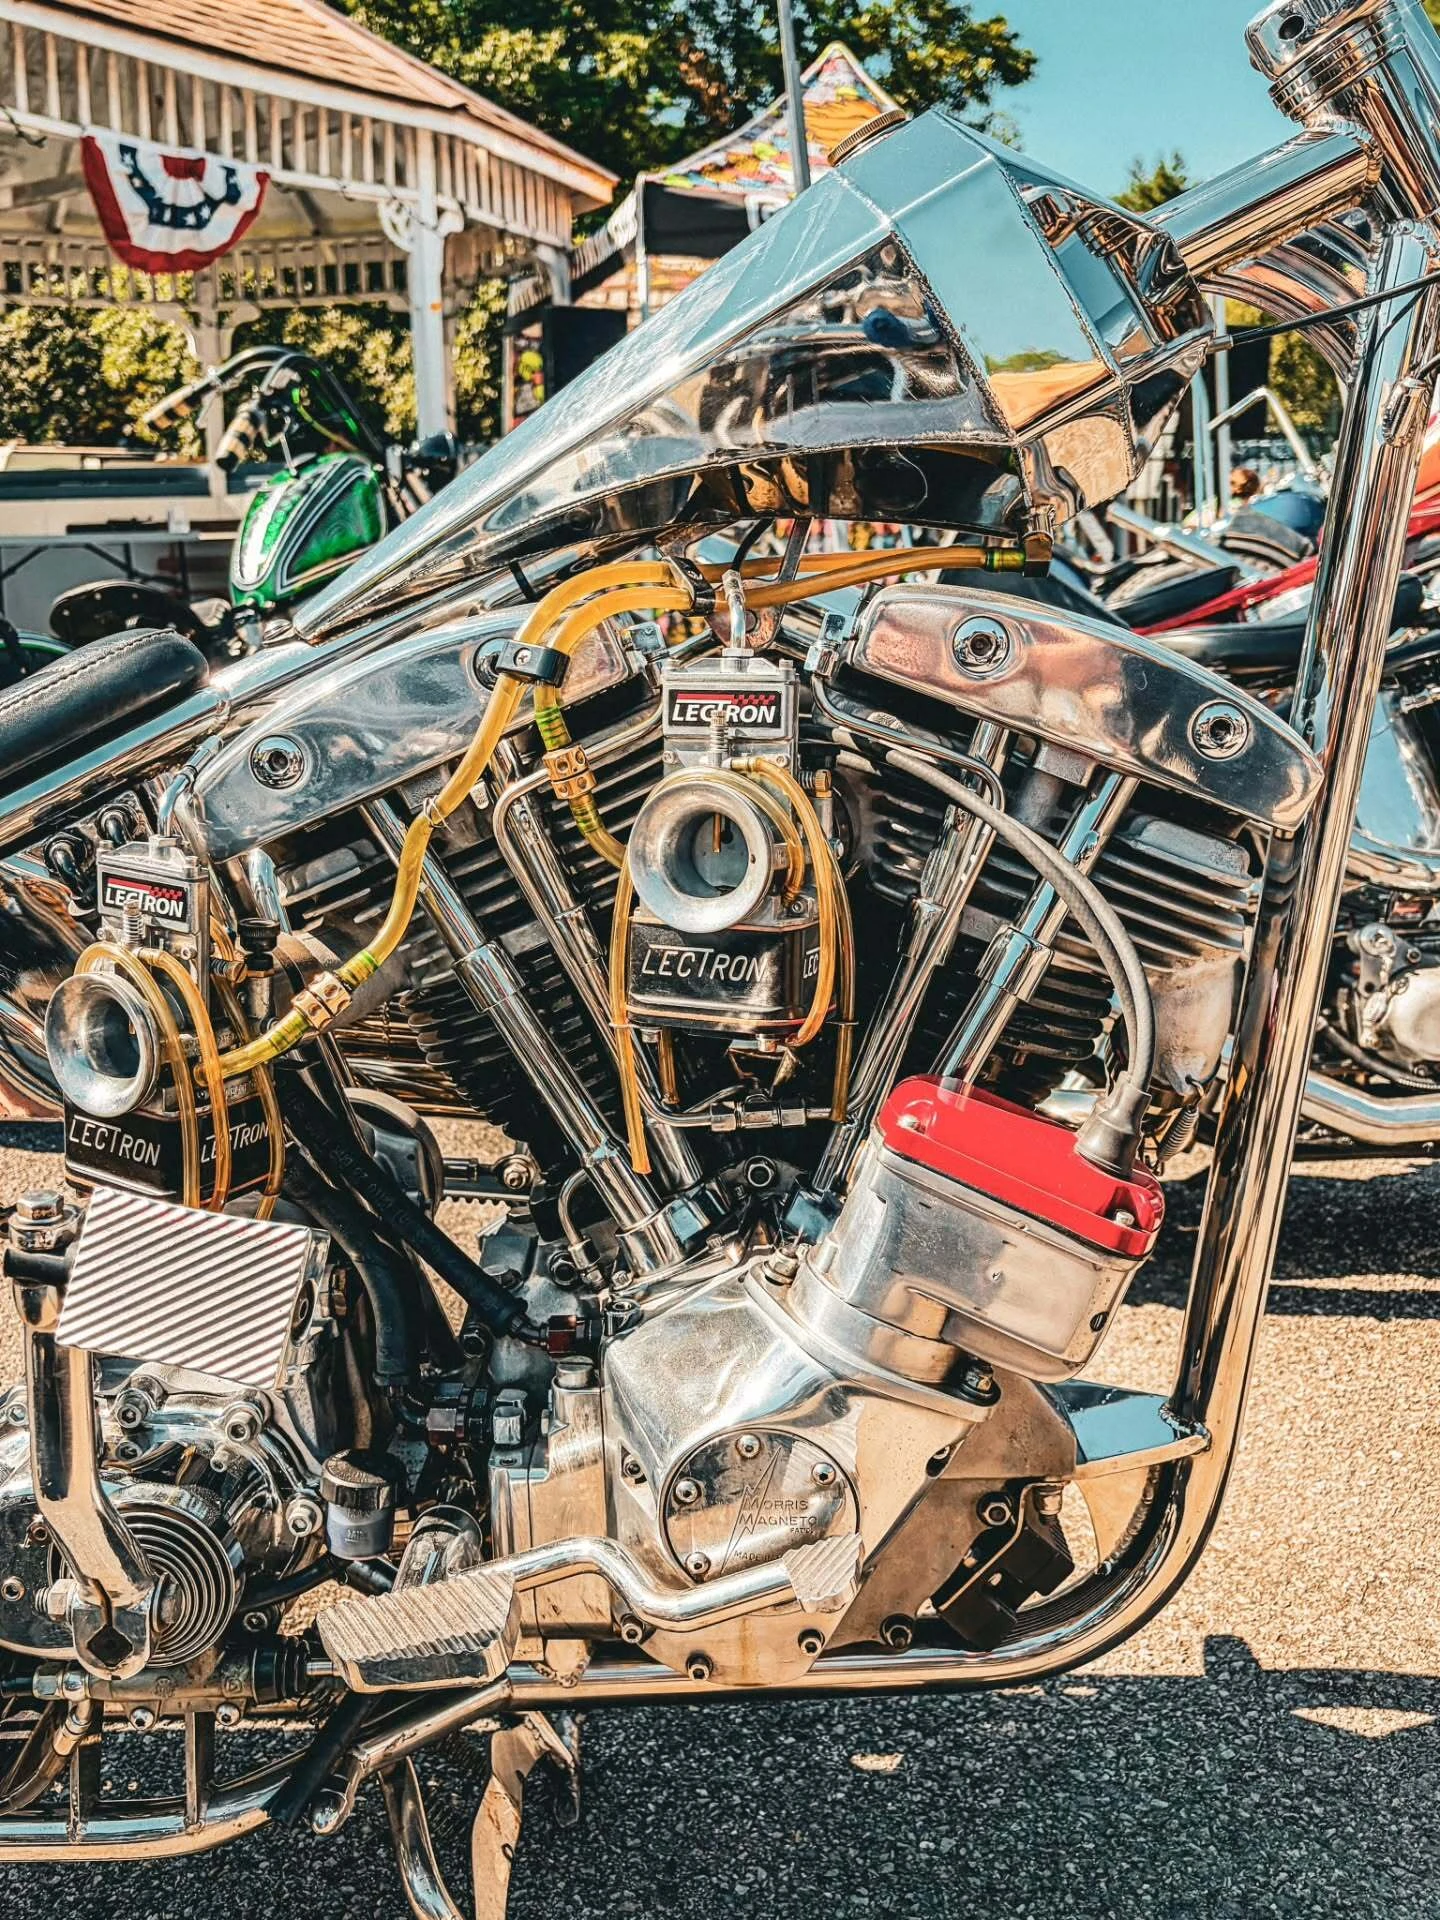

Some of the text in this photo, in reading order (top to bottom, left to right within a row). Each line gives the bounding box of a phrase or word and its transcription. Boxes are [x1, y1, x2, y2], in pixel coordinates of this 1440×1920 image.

[641, 944, 768, 982] LECTRON
[69, 1114, 161, 1167] LECTRON
[201, 1123, 269, 1163] LETRON
[739, 1513, 817, 1527] MAGNETO
[742, 1497, 809, 1511] MORRIS
